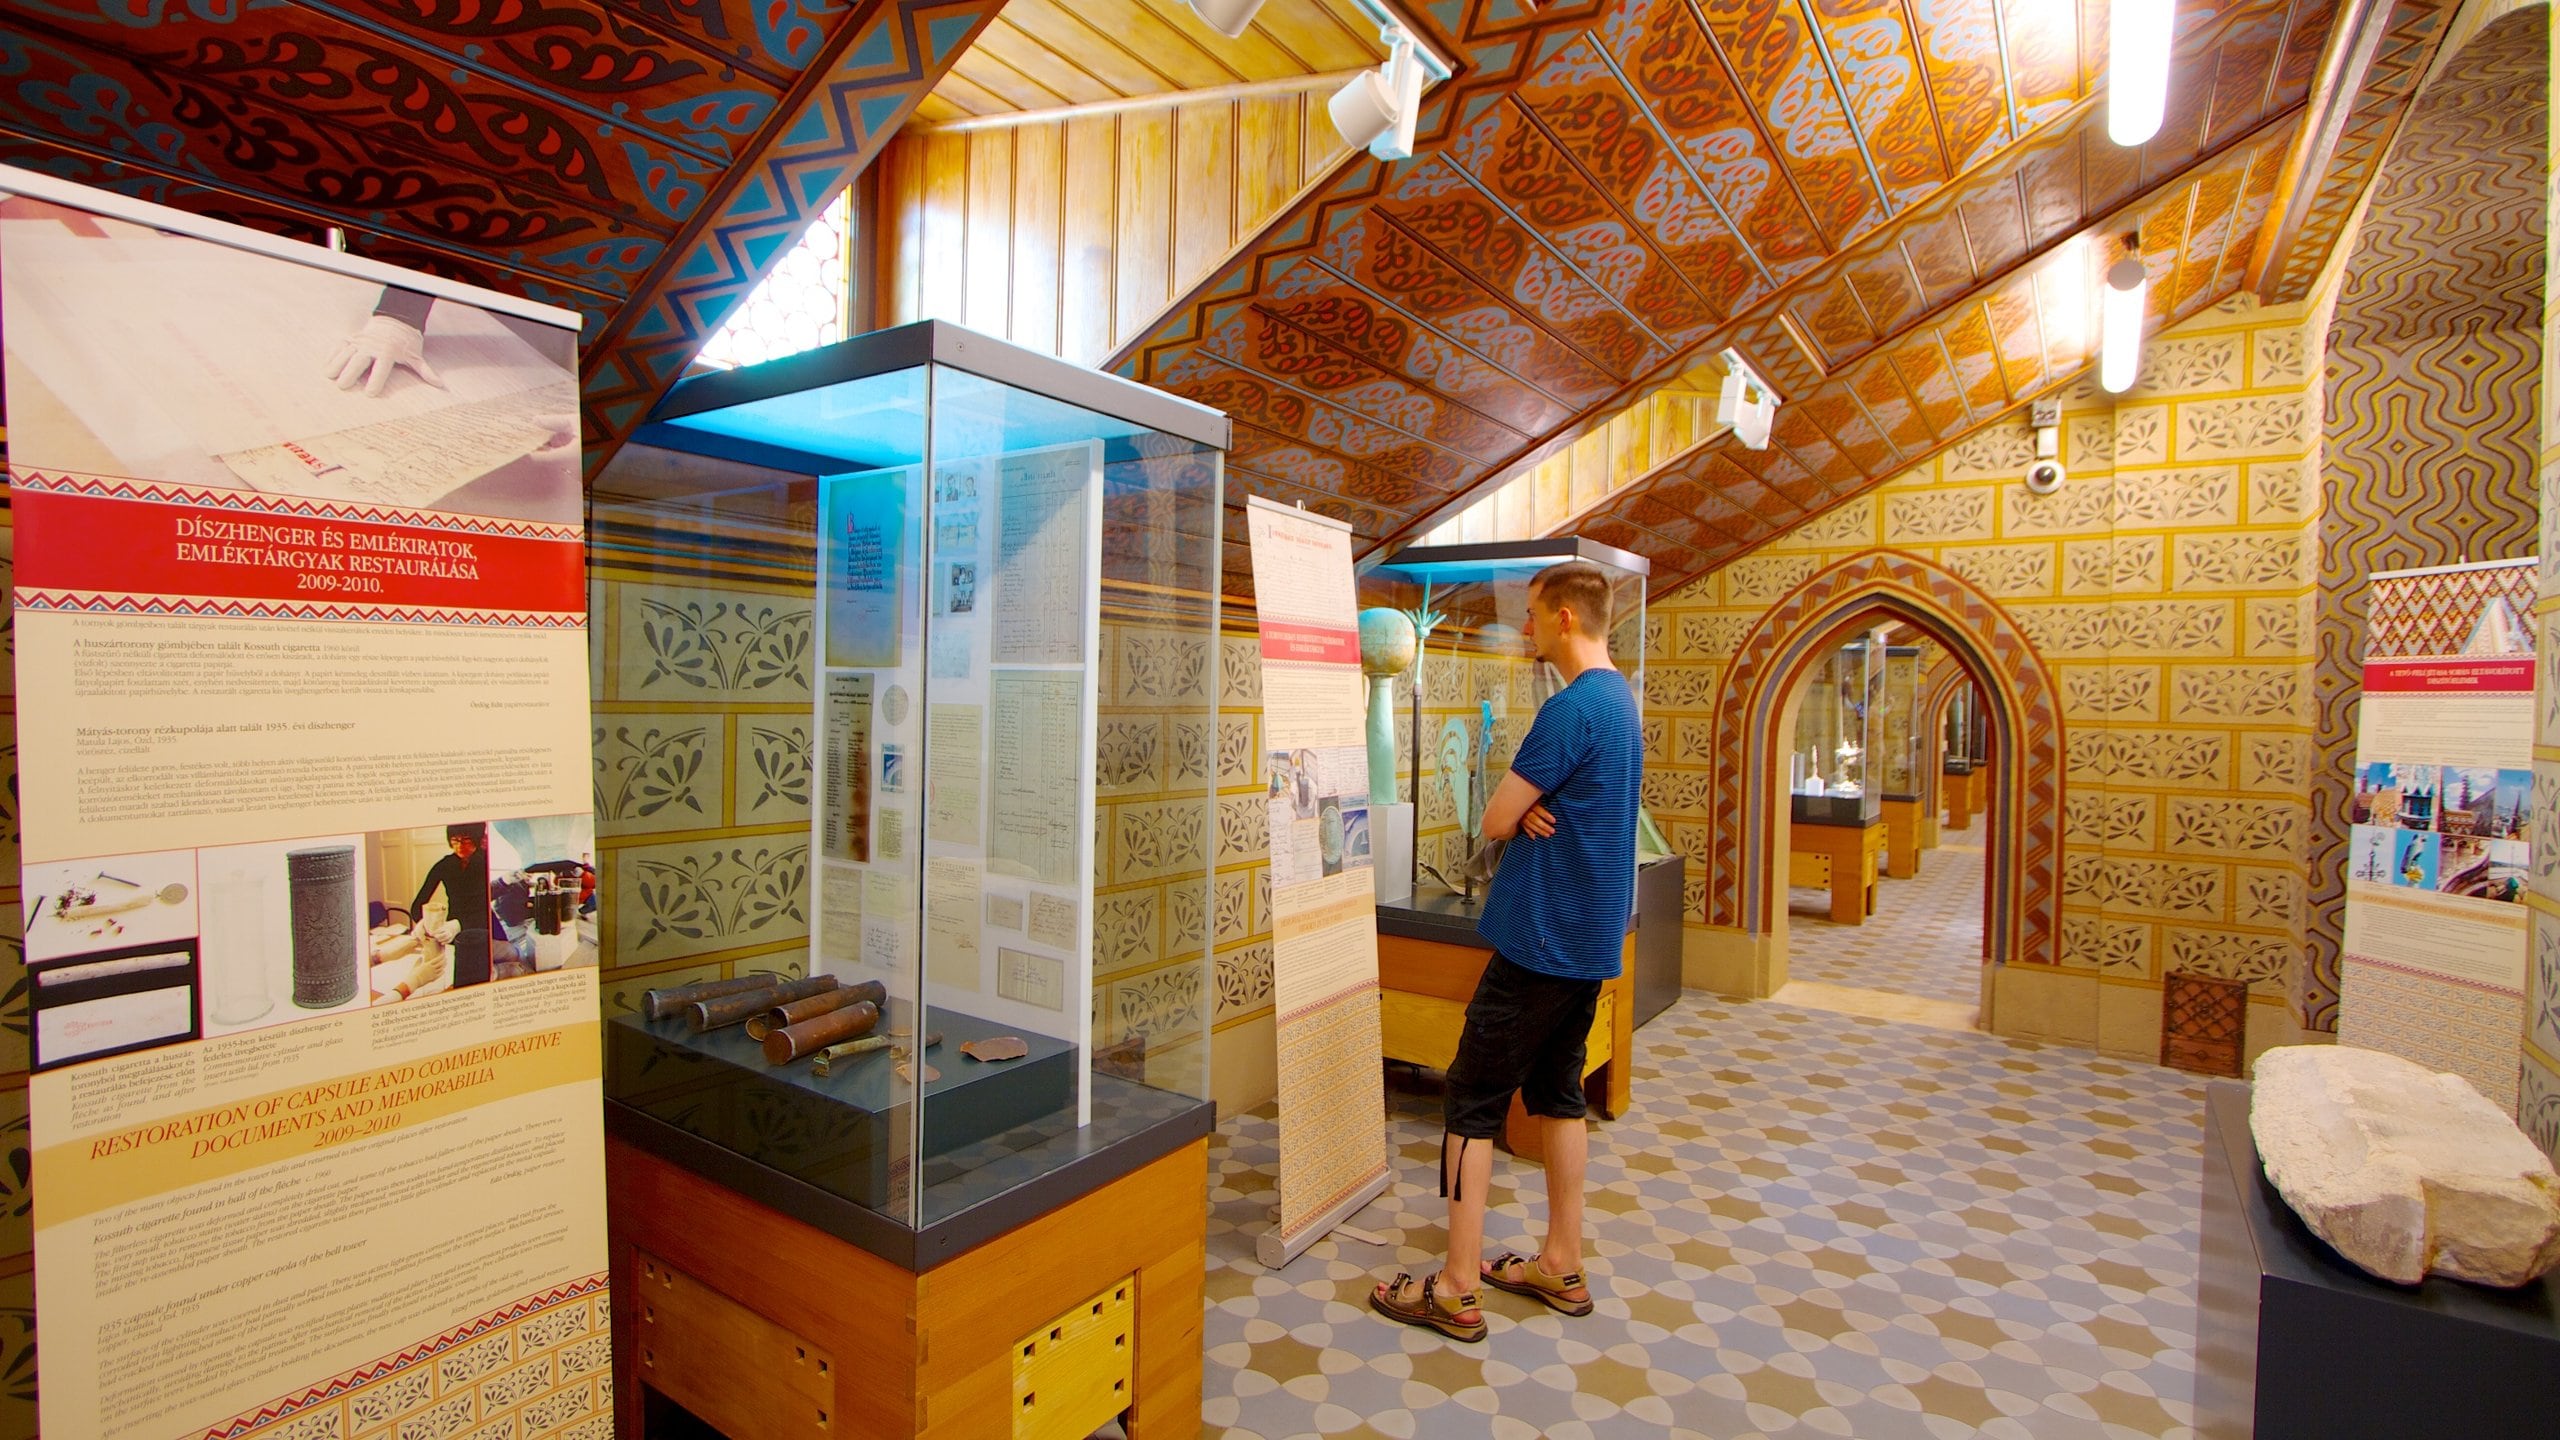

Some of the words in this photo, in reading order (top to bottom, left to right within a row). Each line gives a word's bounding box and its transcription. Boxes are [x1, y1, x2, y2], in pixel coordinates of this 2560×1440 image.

[176, 515, 317, 545] DÍSZHENGER
[322, 526, 344, 548] ÉS
[349, 532, 478, 562] EMLÉKIRATOK,
[177, 542, 344, 570] EMLÉKTÁRGYAK
[350, 555, 479, 579] RESTAURÁLÁSA
[298, 574, 383, 592] 2009-2010.
[73, 639, 80, 648] A
[84, 639, 154, 651] huszártorony
[158, 640, 215, 652] gömbjében
[218, 641, 241, 650] talált
[244, 642, 281, 651] Kossuth
[283, 642, 320, 654] cigaretta
[76, 727, 151, 739] Mátyás-torony
[154, 724, 214, 736] rézkupolája
[216, 724, 238, 733] alatt
[240, 722, 262, 732] talált
[266, 722, 289, 731] 1935.
[157, 735, 176, 744] 1935
[218, 1039, 255, 1051] 1935-ben
[307, 1041, 323, 1050] and
[325, 1038, 343, 1048] glass
[186, 1058, 195, 1066] és
[204, 1052, 232, 1062] fedeles
[261, 1060, 280, 1071] from
[283, 1054, 299, 1064] 1935
[71, 1067, 108, 1081] Kossuth
[112, 1060, 151, 1073] cigaretta
[79, 1083, 127, 1100] restaurálás
[153, 1091, 171, 1101] and
[174, 1087, 196, 1098] after
[156, 1082, 178, 1094] from
[182, 1077, 196, 1085] the
[90, 1106, 250, 1160] RESTORATION
[256, 1097, 283, 1117] OF
[287, 1077, 370, 1109] CAPSULE
[374, 1068, 415, 1090] AND
[418, 1032, 561, 1078] COMMEMORATIVE
[191, 1112, 326, 1159] DOCUMENTS
[330, 1100, 373, 1122] AND
[378, 1068, 495, 1110] MEMORABILIA
[94, 1217, 112, 1226] Two
[113, 1211, 124, 1221] of
[125, 1209, 138, 1218] the
[140, 1202, 164, 1213] many
[167, 1193, 195, 1205] objects
[196, 1183, 222, 1199] found
[224, 1181, 233, 1189] in
[235, 1177, 247, 1186] the
[248, 1172, 270, 1182] tower
[291, 1160, 306, 1171] and
[94, 1225, 134, 1244] Kossuth
[136, 1214, 181, 1232] cigarette
[183, 1202, 213, 1221] found
[215, 1200, 225, 1209] in
[228, 1192, 247, 1205] ball
[248, 1188, 259, 1200] of
[260, 1185, 274, 1196] the
[98, 1319, 122, 1334] 1935
[124, 1307, 164, 1326] capsule
[166, 1294, 197, 1314] found
[199, 1285, 229, 1300] under
[231, 1274, 264, 1289] copper
[265, 1262, 297, 1278] cupola
[298, 1256, 309, 1268] of
[310, 1253, 324, 1264] the
[325, 1245, 341, 1258] bell
[343, 1239, 368, 1253] tower
